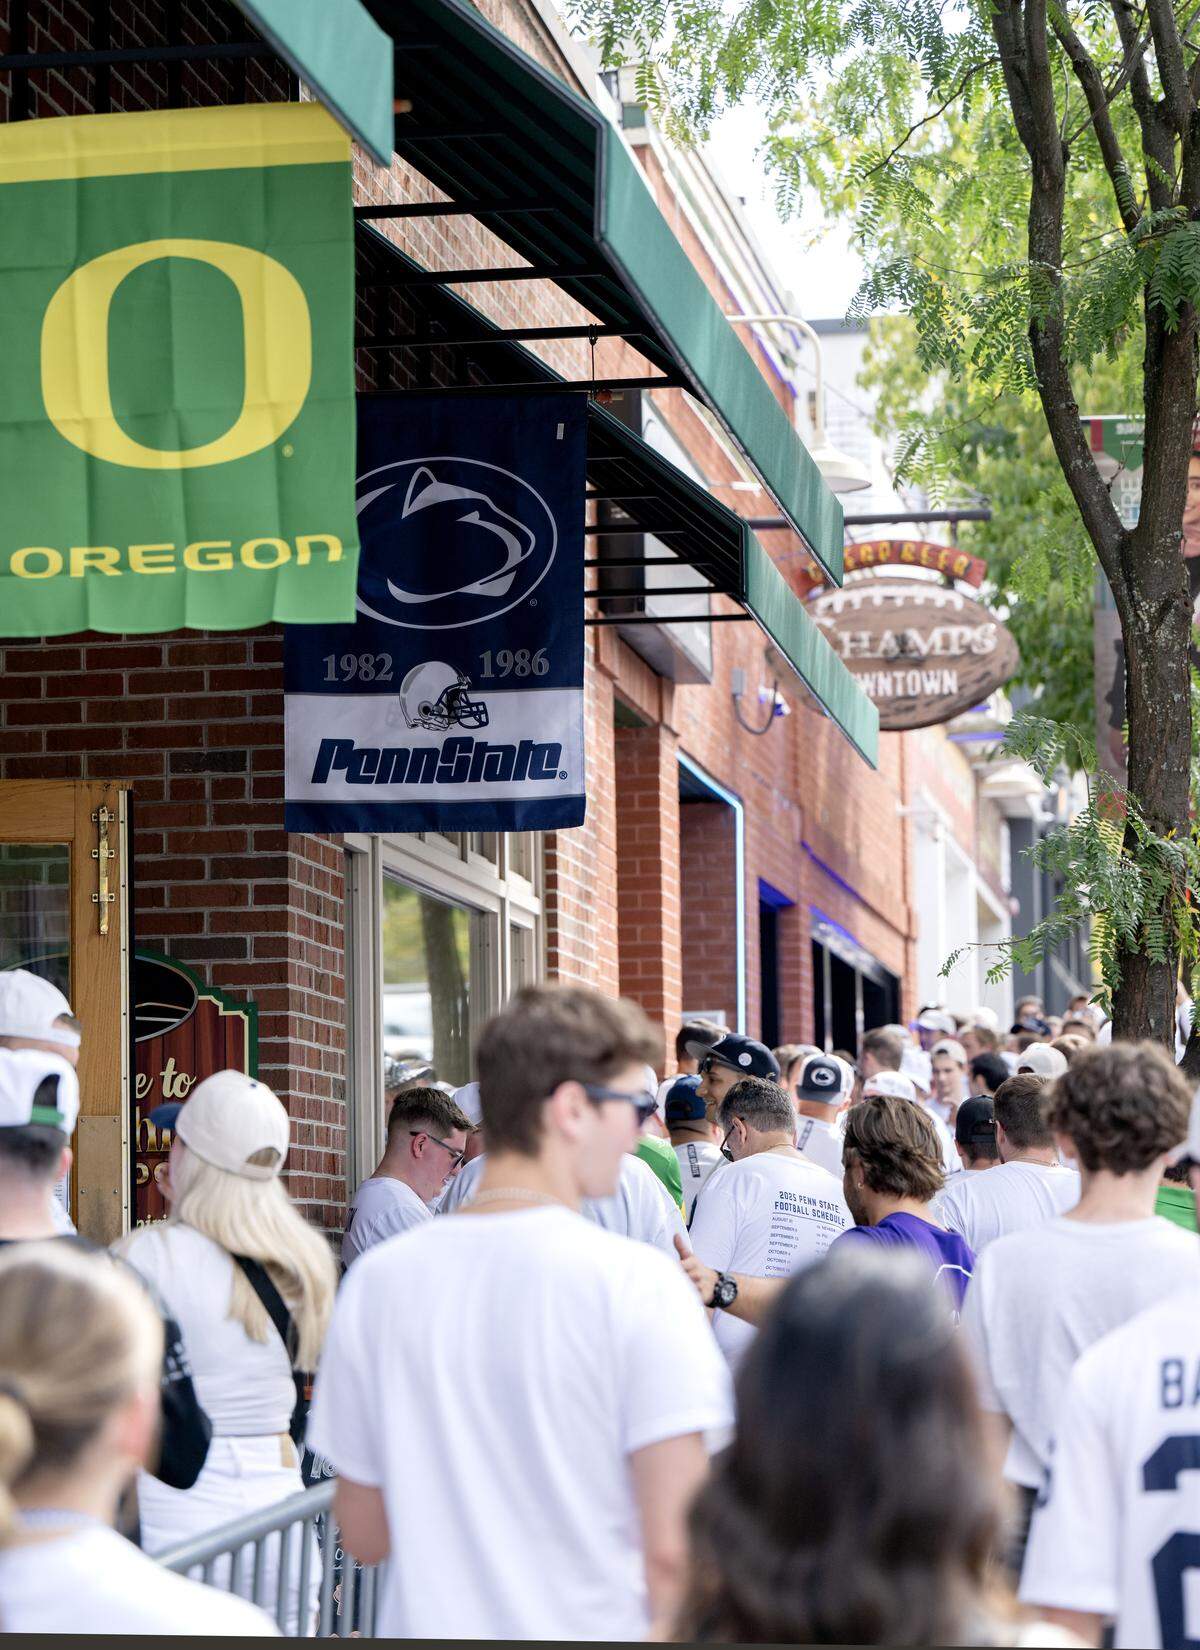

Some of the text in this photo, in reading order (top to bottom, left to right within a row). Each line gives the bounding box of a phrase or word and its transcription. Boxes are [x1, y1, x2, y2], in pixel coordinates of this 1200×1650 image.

[40, 238, 313, 470] O
[322, 648, 551, 682] 1982 1986
[159, 1057, 197, 1099] to
[775, 1201, 845, 1227] FOOTBALL SCHEDULE
[779, 1191, 840, 1214] 2025 PENN STATE
